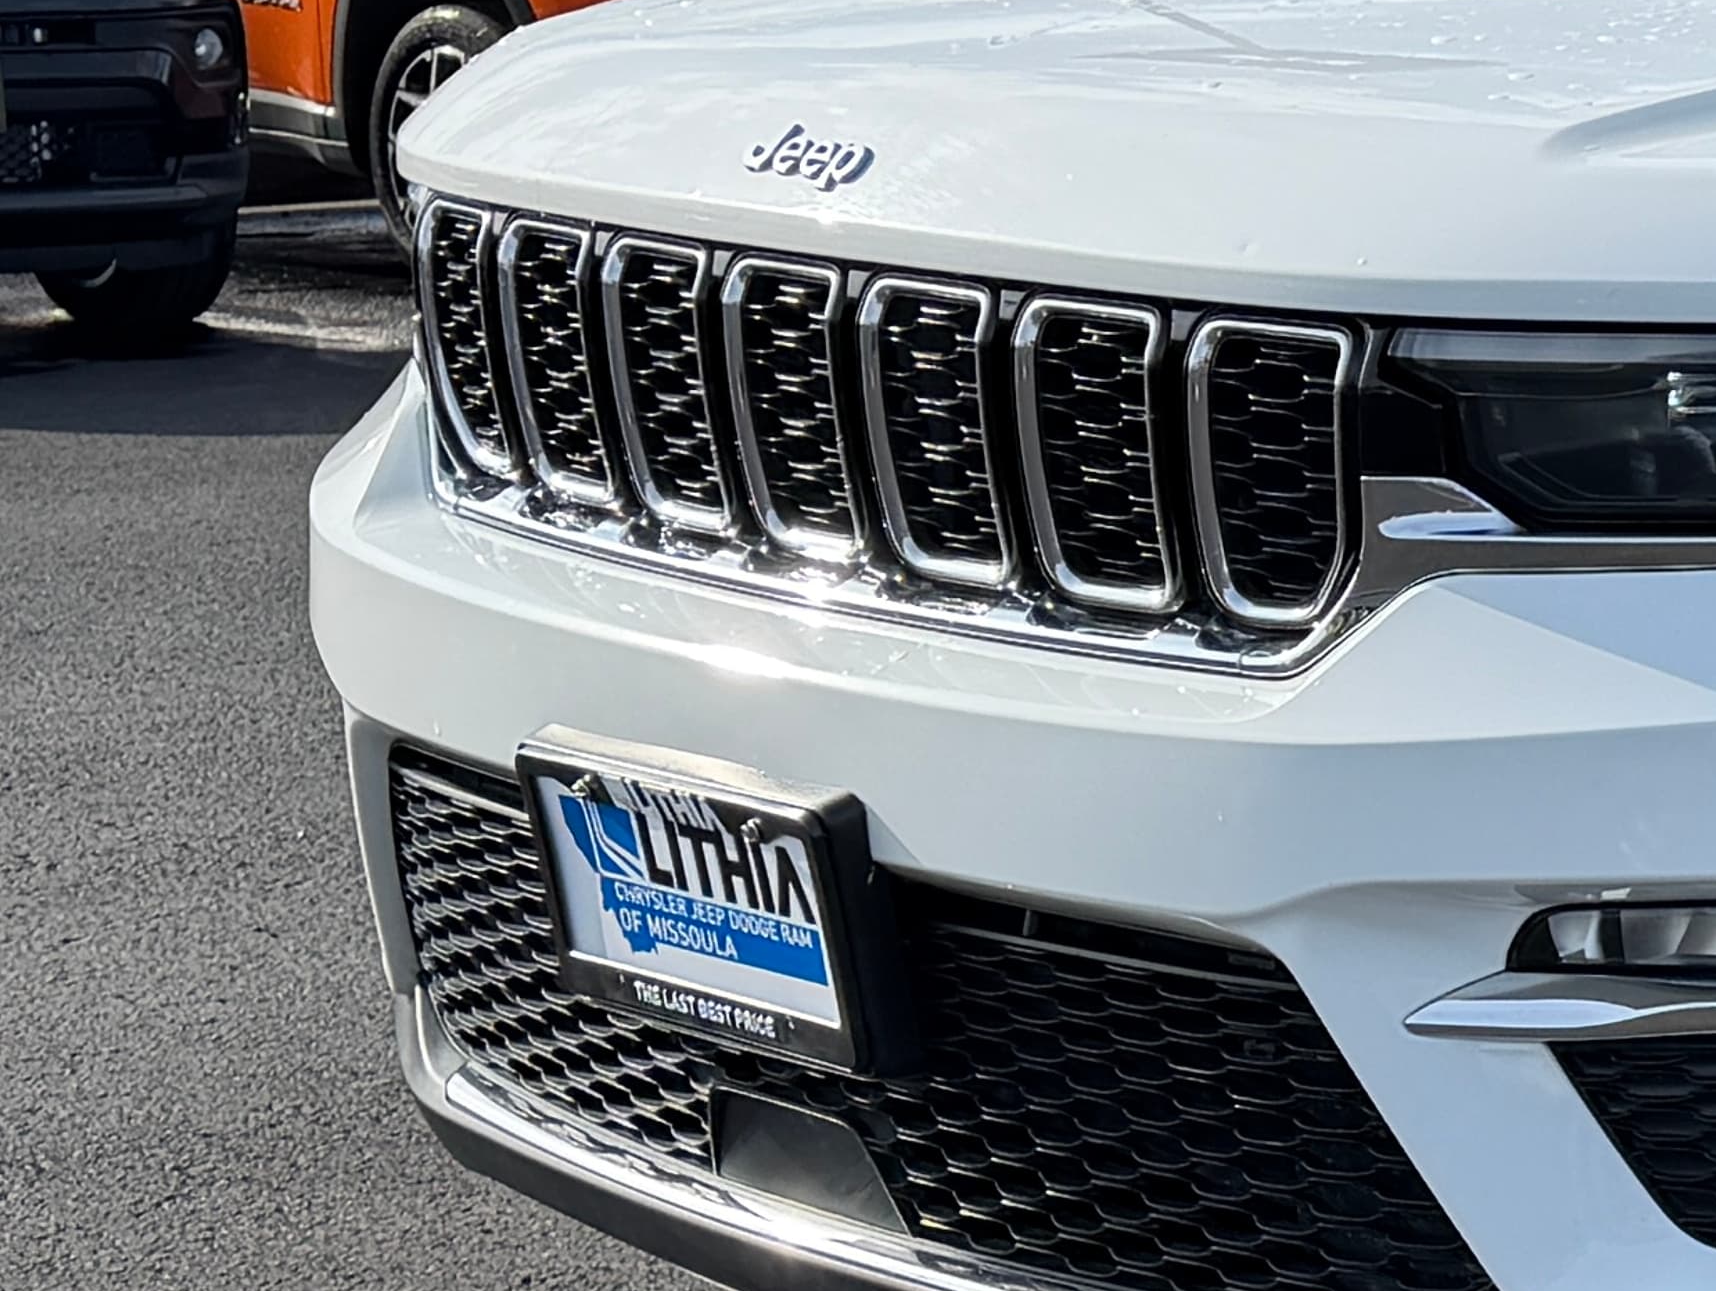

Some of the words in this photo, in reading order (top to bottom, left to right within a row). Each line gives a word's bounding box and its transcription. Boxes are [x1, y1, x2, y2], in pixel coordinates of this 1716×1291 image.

[742, 123, 875, 193] Jeep
[635, 810, 817, 926] LITHIA
[614, 881, 689, 917] CHRYSLER
[690, 900, 726, 928] JEEP
[729, 911, 780, 941] DODGE
[781, 924, 815, 950] RAM
[618, 906, 644, 933] OF
[647, 917, 740, 961] MISSOULA
[632, 979, 661, 1006] THE
[661, 988, 697, 1015] LAST
[697, 1000, 734, 1027] BEST
[734, 1010, 777, 1039] PRICE
